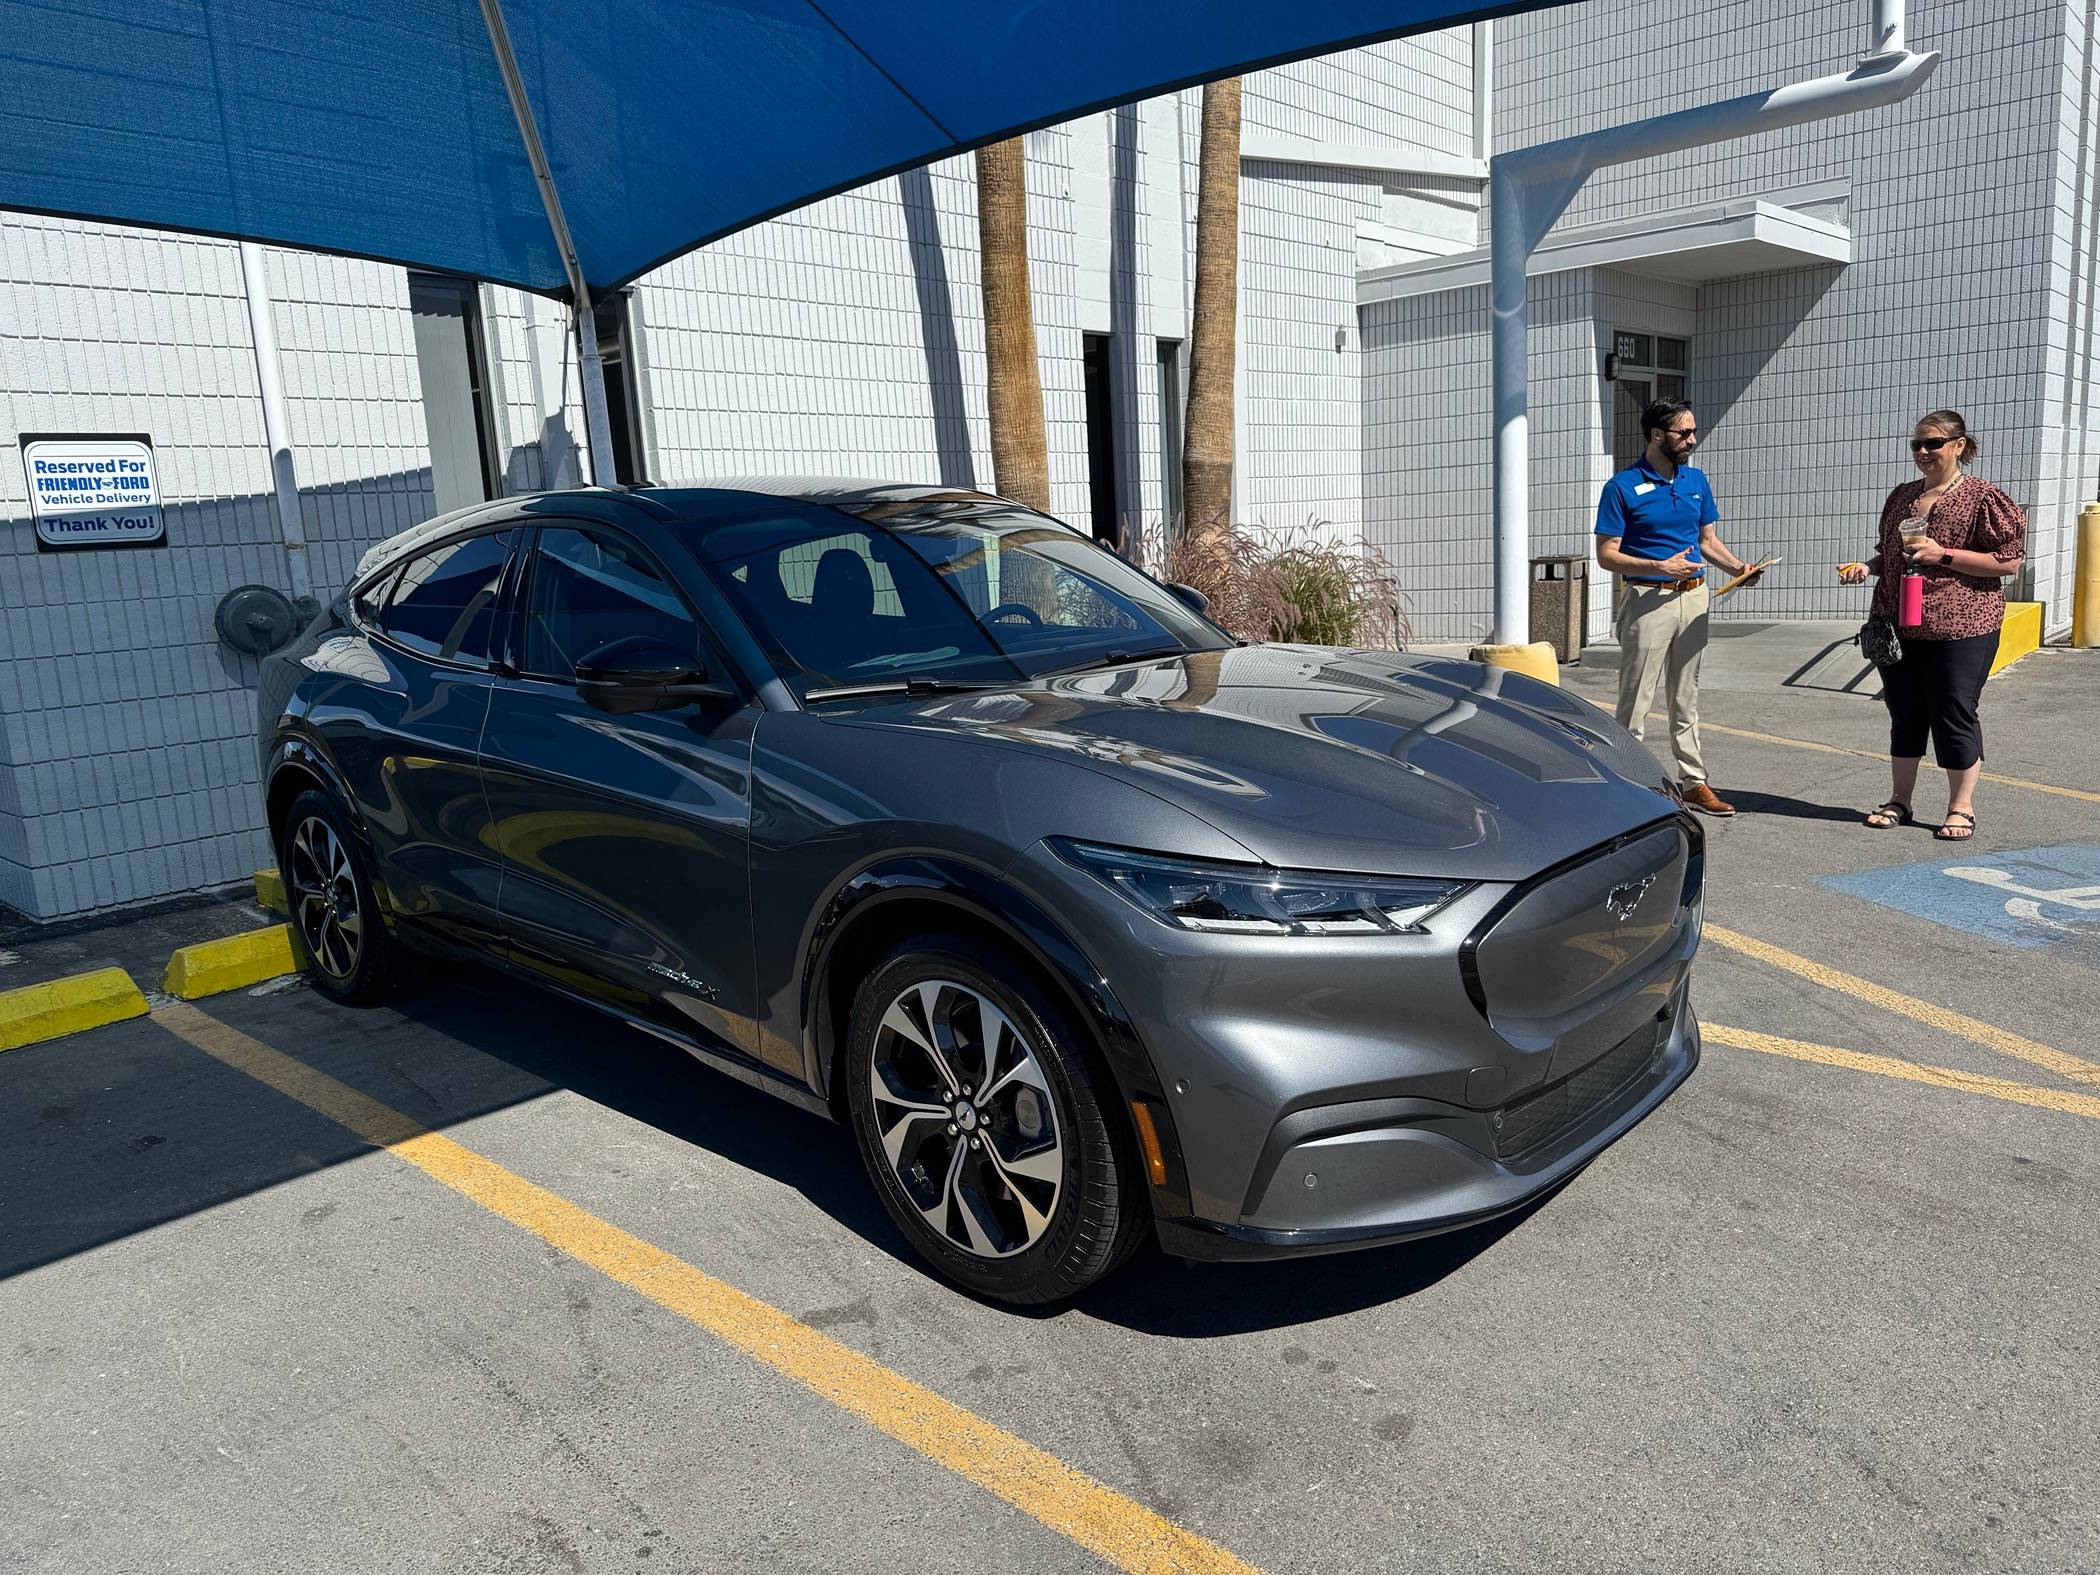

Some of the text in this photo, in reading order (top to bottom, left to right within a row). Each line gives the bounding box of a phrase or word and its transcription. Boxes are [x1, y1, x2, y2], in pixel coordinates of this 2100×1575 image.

[1618, 337, 1634, 358] 660
[34, 460, 145, 473] Reserved For
[37, 477, 149, 491] FRIENDLY FORD
[41, 493, 151, 504] Vehicle Delivery
[44, 516, 154, 532] Thank You!
